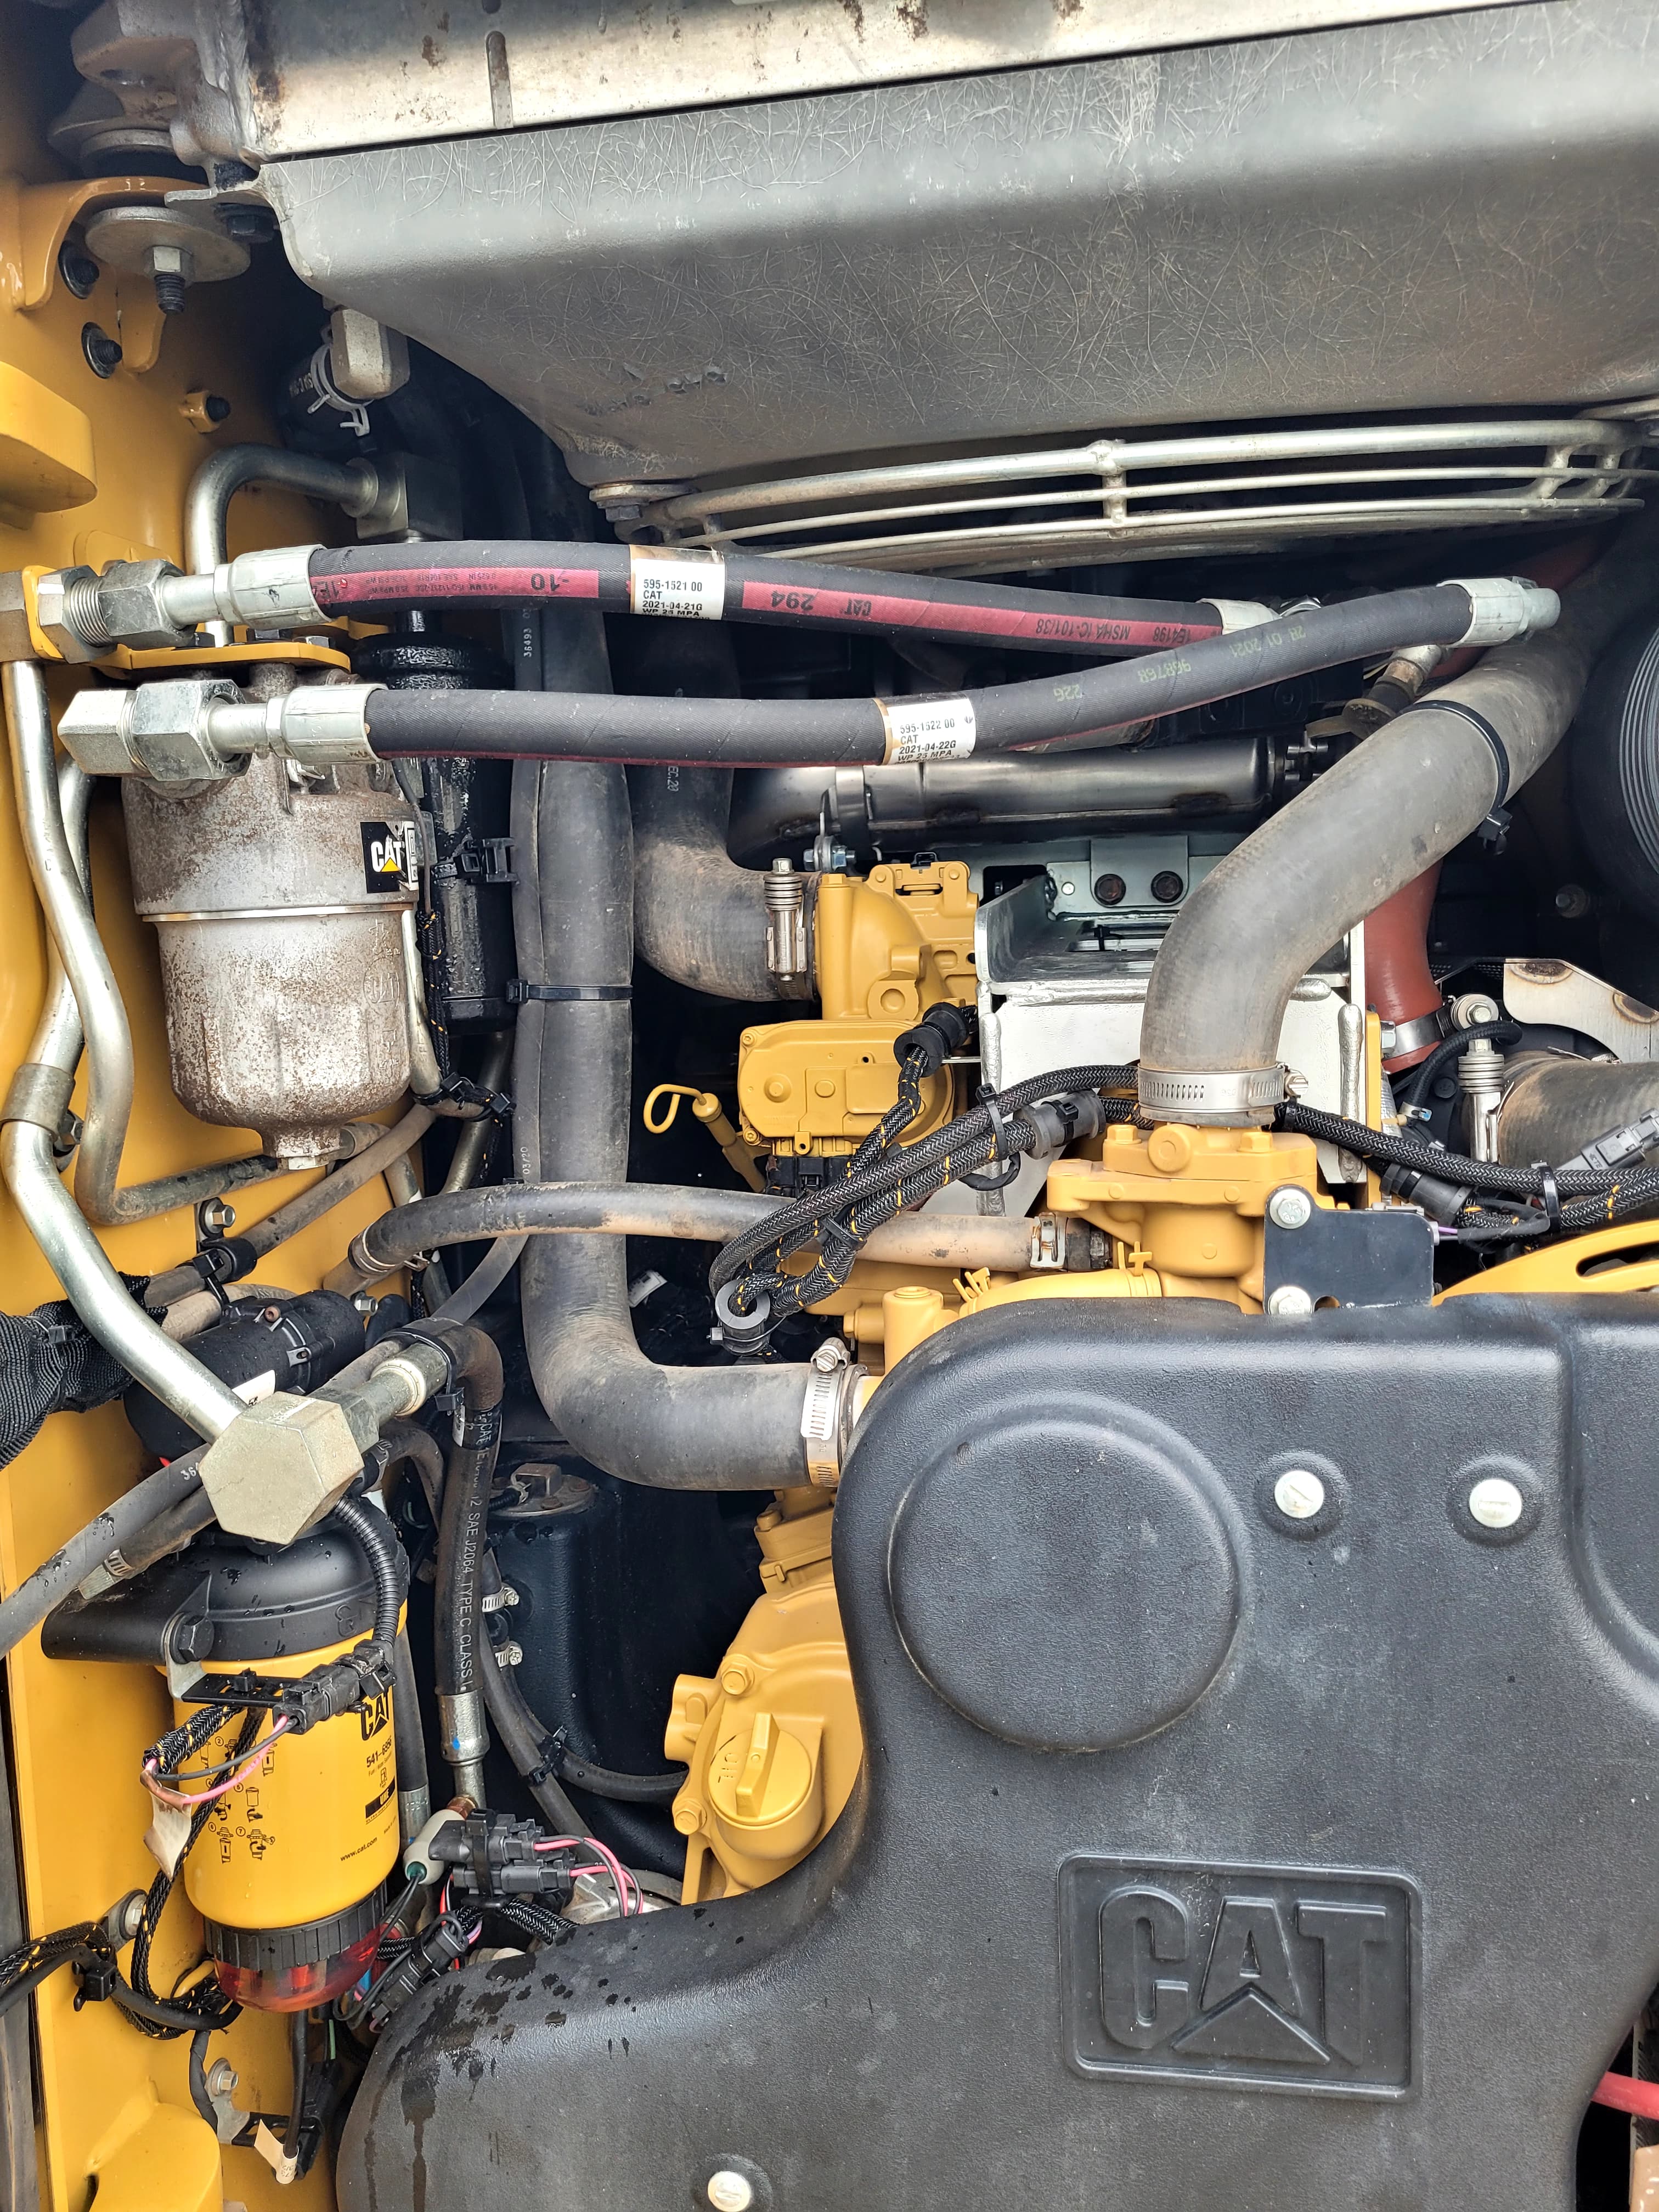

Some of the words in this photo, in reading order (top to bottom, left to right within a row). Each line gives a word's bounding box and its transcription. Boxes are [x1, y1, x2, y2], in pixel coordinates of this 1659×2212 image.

[530, 573, 571, 593] -10
[643, 579, 687, 591] 595-1521
[691, 582, 703, 592] 00
[643, 590, 663, 600] CAT
[771, 591, 815, 612] 294
[642, 600, 703, 611] 2021-04-21G
[845, 599, 873, 618] CAT
[1097, 623, 1131, 641] MSHA
[1152, 626, 1191, 644] 1E4198
[523, 627, 533, 658] 36493
[900, 720, 942, 734] 595-1522
[944, 718, 955, 729] 00
[899, 740, 957, 755] 2021-04-22G
[900, 734, 919, 745] CAT
[930, 749, 952, 758] MPA
[370, 838, 404, 873] CAT
[520, 1146, 532, 1175] 03/20
[466, 1513, 480, 1536] SAE
[462, 1539, 477, 1573] J2064
[459, 1579, 473, 1613] TYPE
[459, 1617, 472, 1627] C
[459, 1634, 473, 1678] CLASS
[340, 1836, 378, 1862] www.cat.com
[1098, 1884, 1390, 2067] CAT
